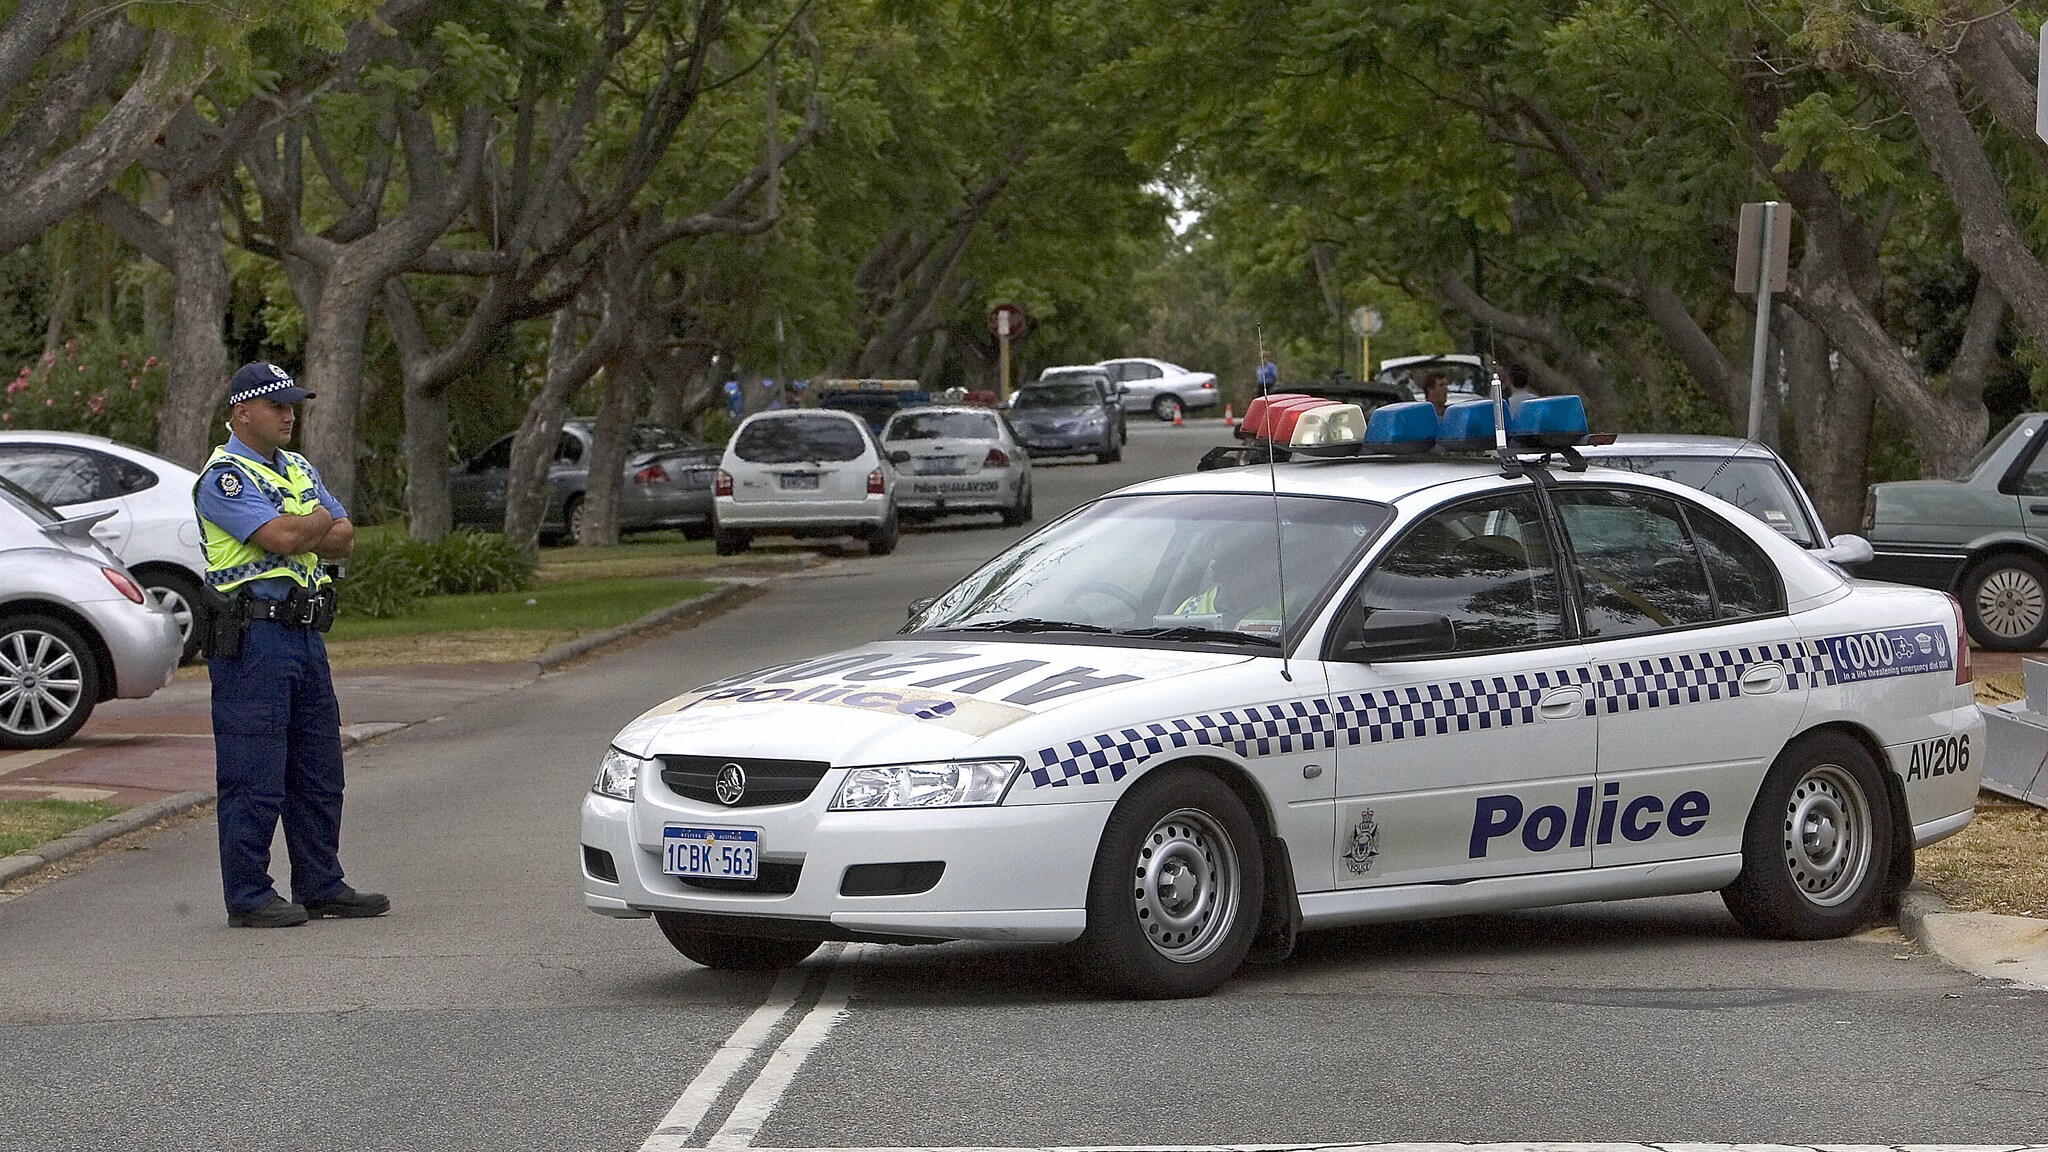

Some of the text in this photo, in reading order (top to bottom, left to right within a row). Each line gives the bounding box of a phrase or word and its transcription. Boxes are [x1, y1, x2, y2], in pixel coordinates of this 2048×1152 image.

[1846, 633, 1893, 669] 000
[1843, 672, 1850, 680] In
[1857, 670, 1867, 678] life
[1868, 666, 1900, 677] threatening
[1900, 664, 1928, 674] emergency
[1929, 661, 1938, 670] dial
[1907, 734, 1970, 783] AV206
[1468, 782, 1711, 859] Police
[1351, 863, 1369, 871] POLICE
